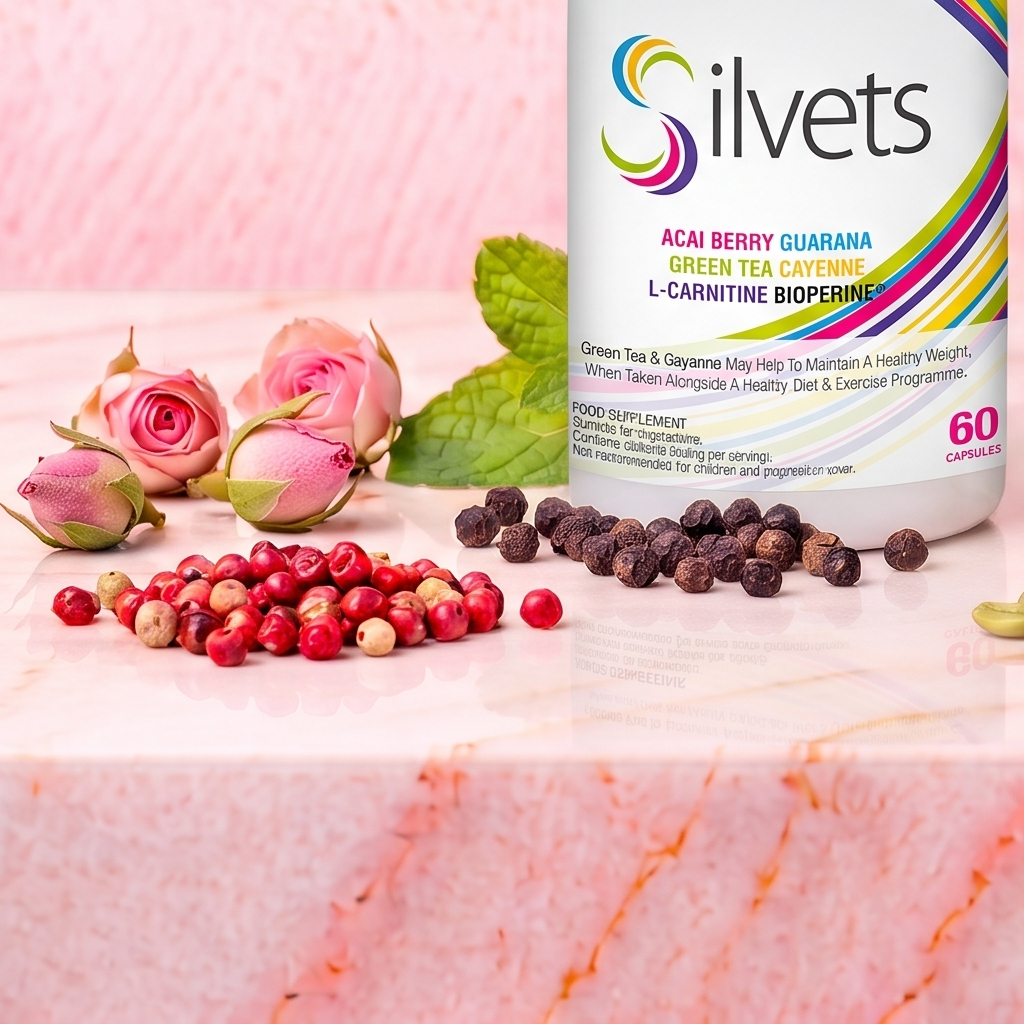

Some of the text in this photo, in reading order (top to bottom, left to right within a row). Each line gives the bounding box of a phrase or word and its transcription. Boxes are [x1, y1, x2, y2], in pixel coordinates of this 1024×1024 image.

[600, 34, 932, 196] Silvets
[661, 228, 872, 252] ACAI BERRY GUARANA
[669, 255, 865, 278] GREEN TEA CAYENNE
[649, 279, 768, 304] L-CARNITINE
[581, 341, 621, 360] Green
[624, 347, 646, 363] Tea
[650, 351, 660, 365] &
[726, 357, 752, 374] May
[757, 358, 785, 375] Help
[788, 358, 802, 372] To
[806, 356, 860, 372] Maintain
[863, 354, 873, 369] A
[876, 350, 922, 367] Healthy
[925, 344, 972, 364] Weight,
[585, 362, 622, 380] When
[625, 368, 662, 386] Taken
[730, 378, 740, 391] A
[794, 378, 818, 392] Diet
[822, 377, 832, 391] &
[836, 374, 887, 391] Exercise
[891, 367, 968, 387] Programme.
[572, 401, 605, 418] FOOD
[949, 406, 999, 446] 60
[708, 451, 725, 464] per
[945, 443, 1002, 463] CAPSULES
[676, 460, 691, 473] for
[740, 465, 760, 477] and
